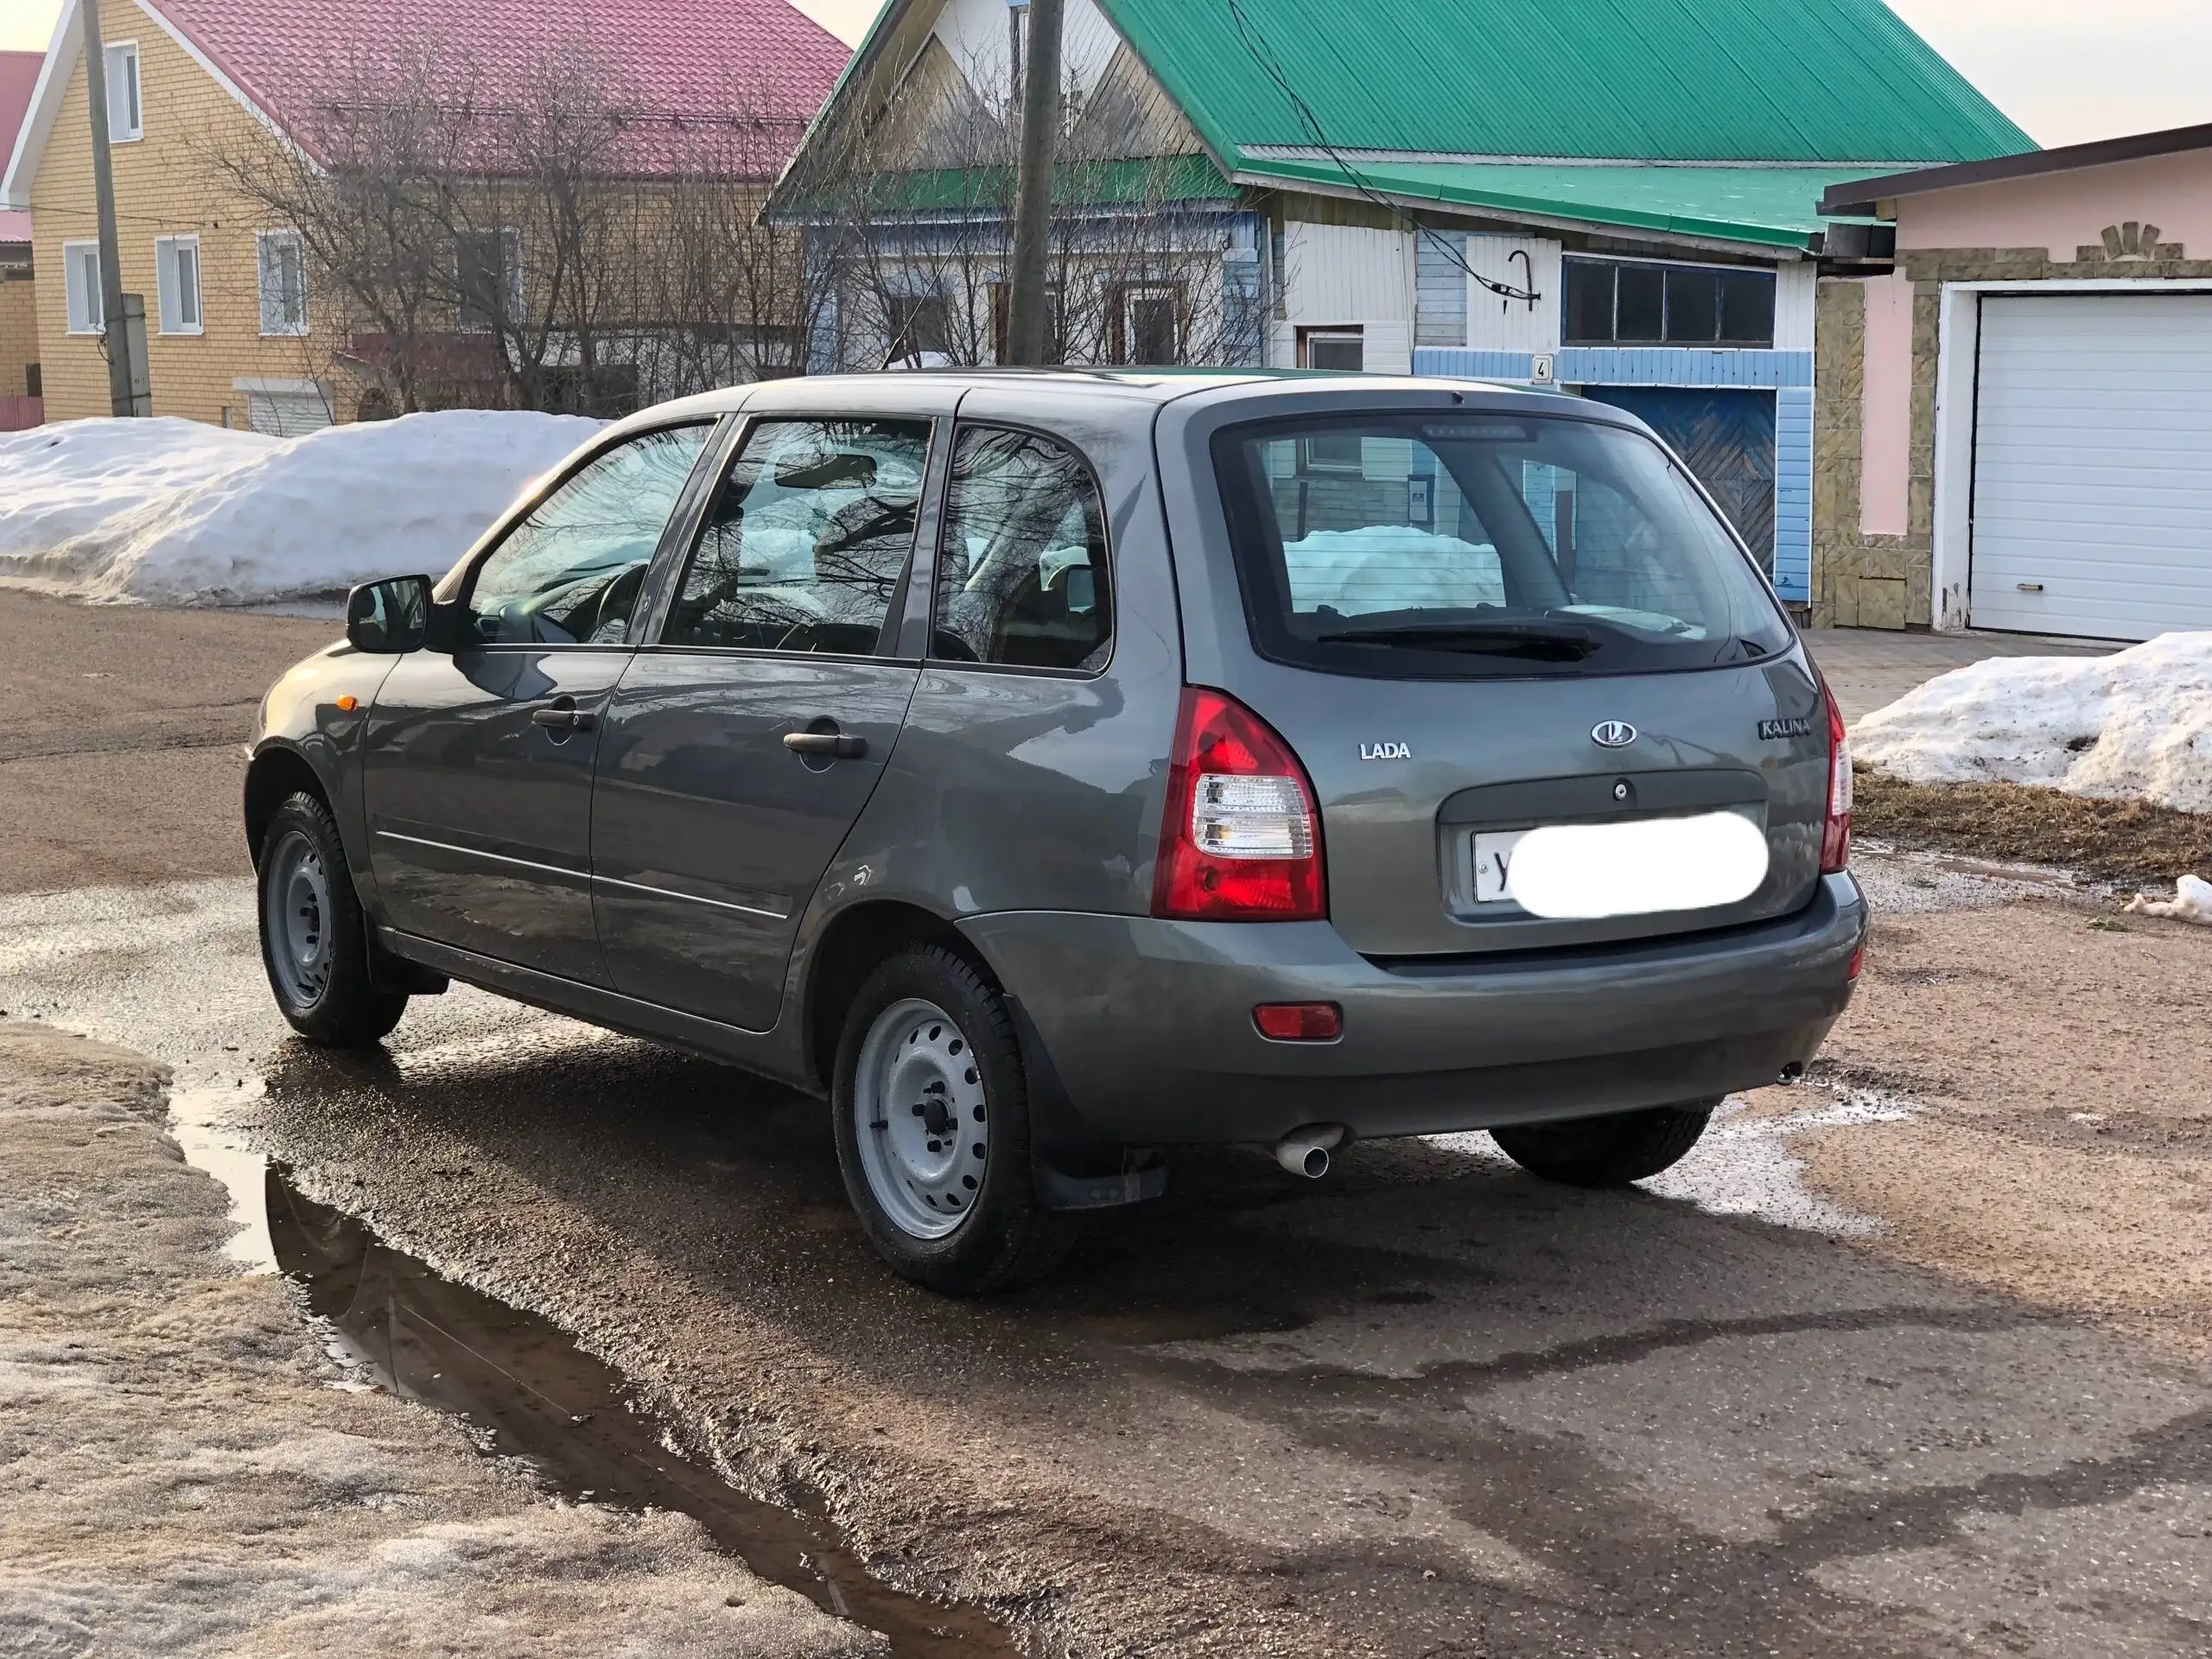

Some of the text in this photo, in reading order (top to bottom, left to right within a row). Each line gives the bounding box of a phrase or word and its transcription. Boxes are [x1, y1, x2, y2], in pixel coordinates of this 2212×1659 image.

[1538, 361, 1544, 377] 4
[1761, 718, 1811, 737] KALINA
[1359, 742, 1411, 760] LADA
